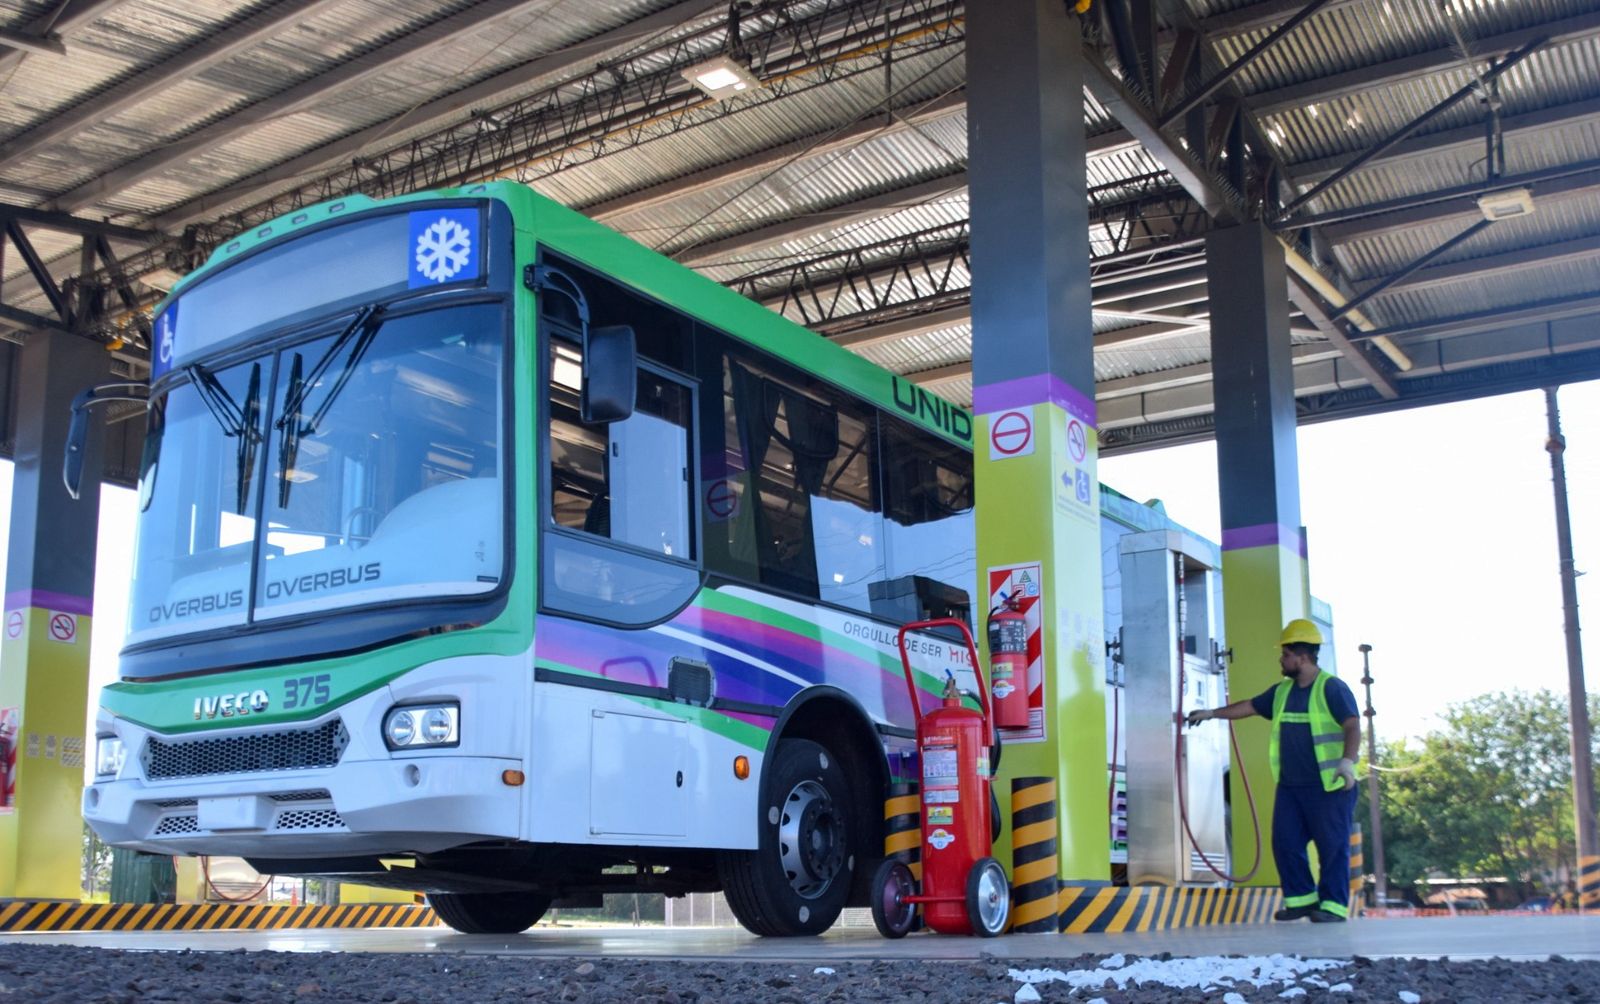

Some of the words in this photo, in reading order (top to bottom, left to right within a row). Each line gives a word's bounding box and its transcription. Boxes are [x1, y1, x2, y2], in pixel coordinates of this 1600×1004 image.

[892, 375, 972, 442] UNID
[265, 562, 381, 599] OVERBUS
[149, 590, 242, 623] OVERBUS
[920, 642, 942, 658] SER
[193, 689, 269, 720] IVECO
[283, 673, 331, 709] 375
